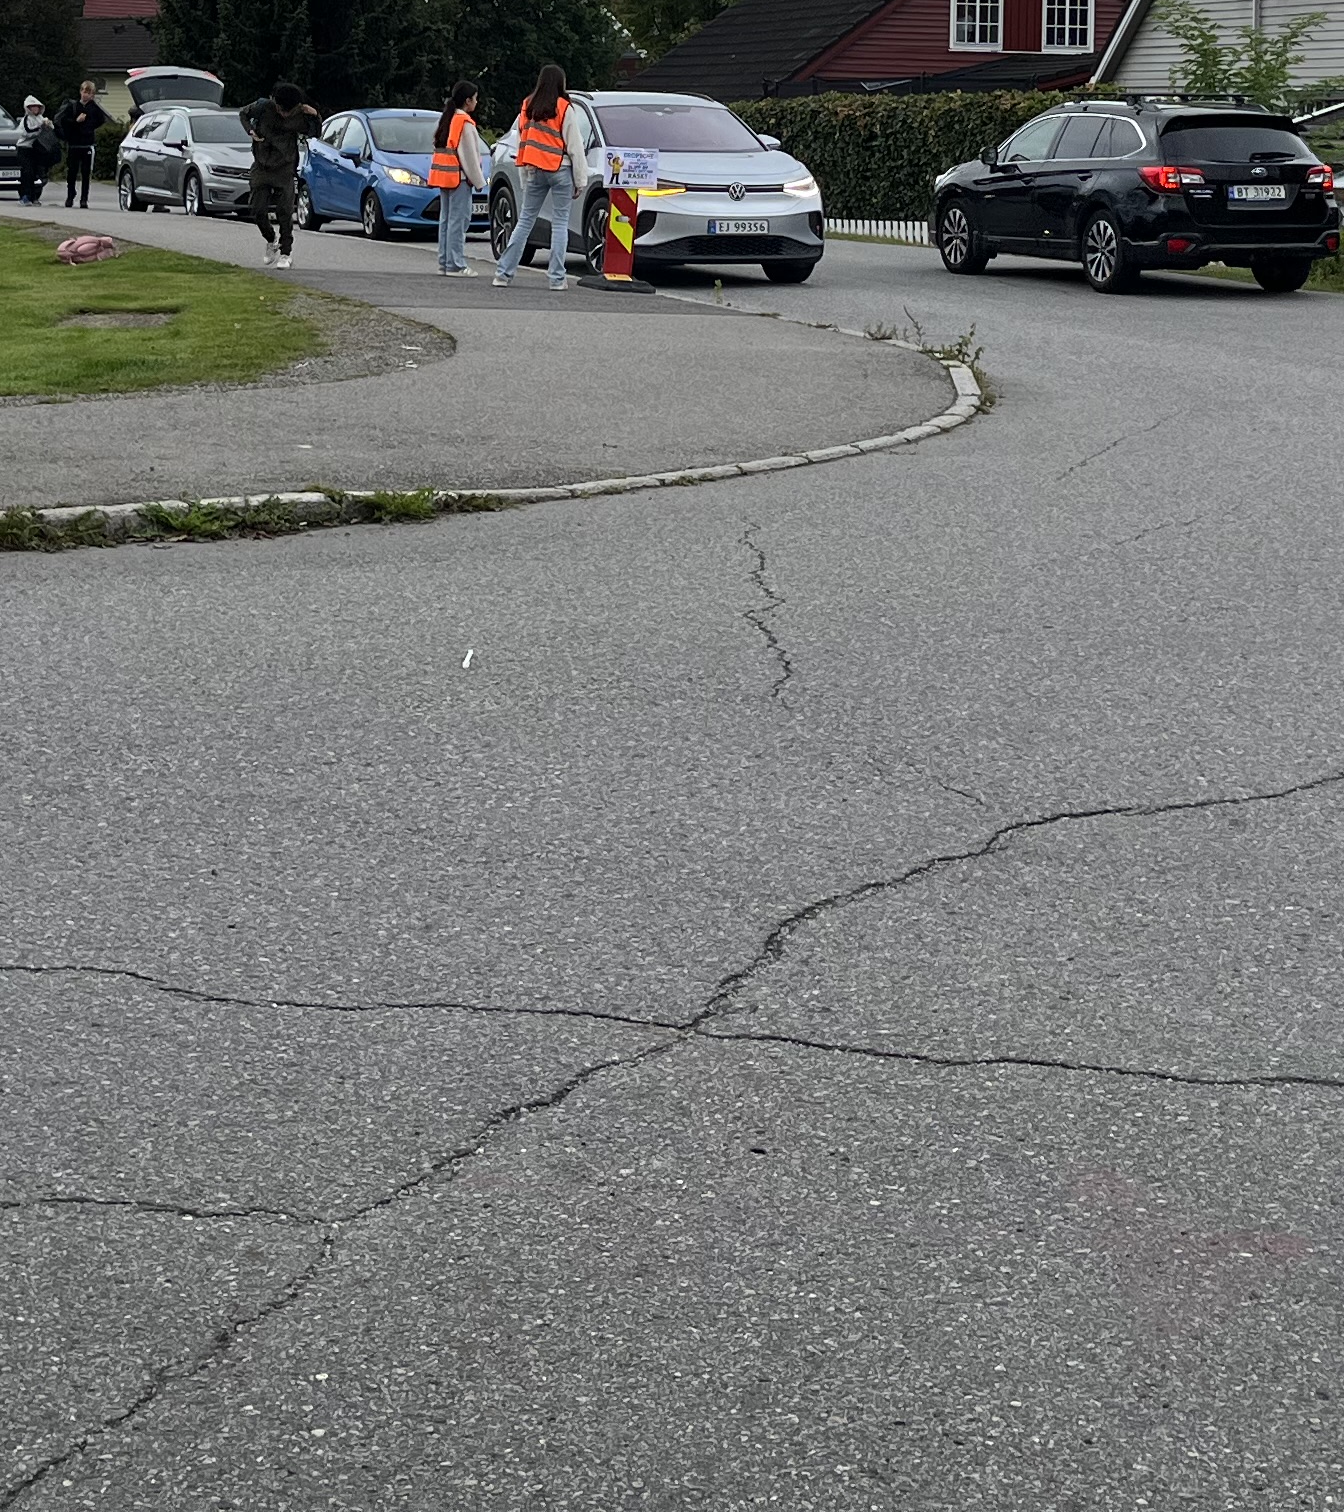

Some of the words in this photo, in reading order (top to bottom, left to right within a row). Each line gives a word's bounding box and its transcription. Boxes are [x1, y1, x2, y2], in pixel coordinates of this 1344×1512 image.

[1237, 187, 1249, 197] BT
[719, 222, 730, 232] EJ
[734, 222, 766, 232] 99356
